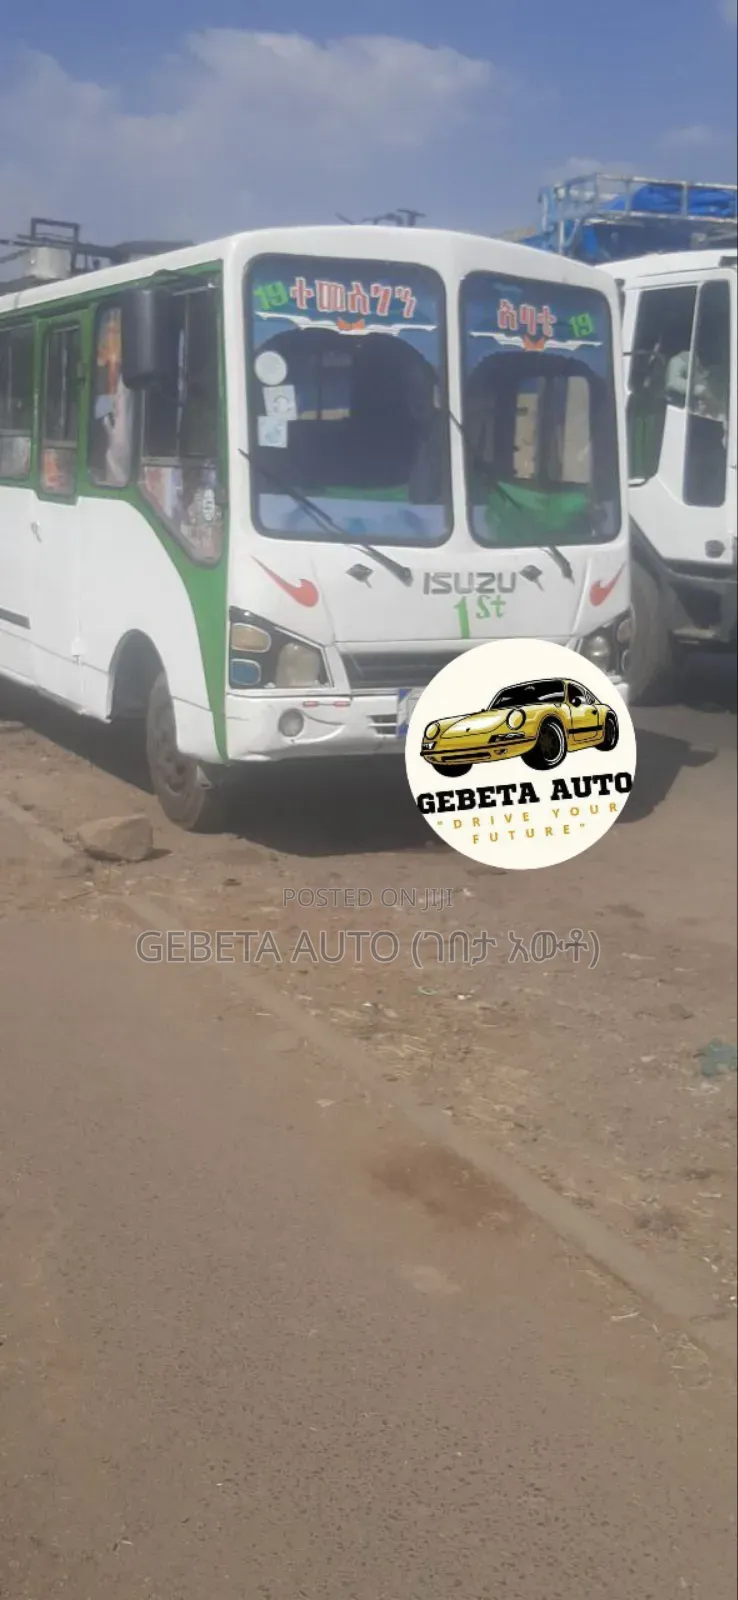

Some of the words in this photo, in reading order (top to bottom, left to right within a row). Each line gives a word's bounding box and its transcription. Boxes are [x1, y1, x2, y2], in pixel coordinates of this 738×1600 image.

[253, 280, 289, 310] 19
[569, 312, 594, 338] 19
[423, 571, 517, 595] ISUZU
